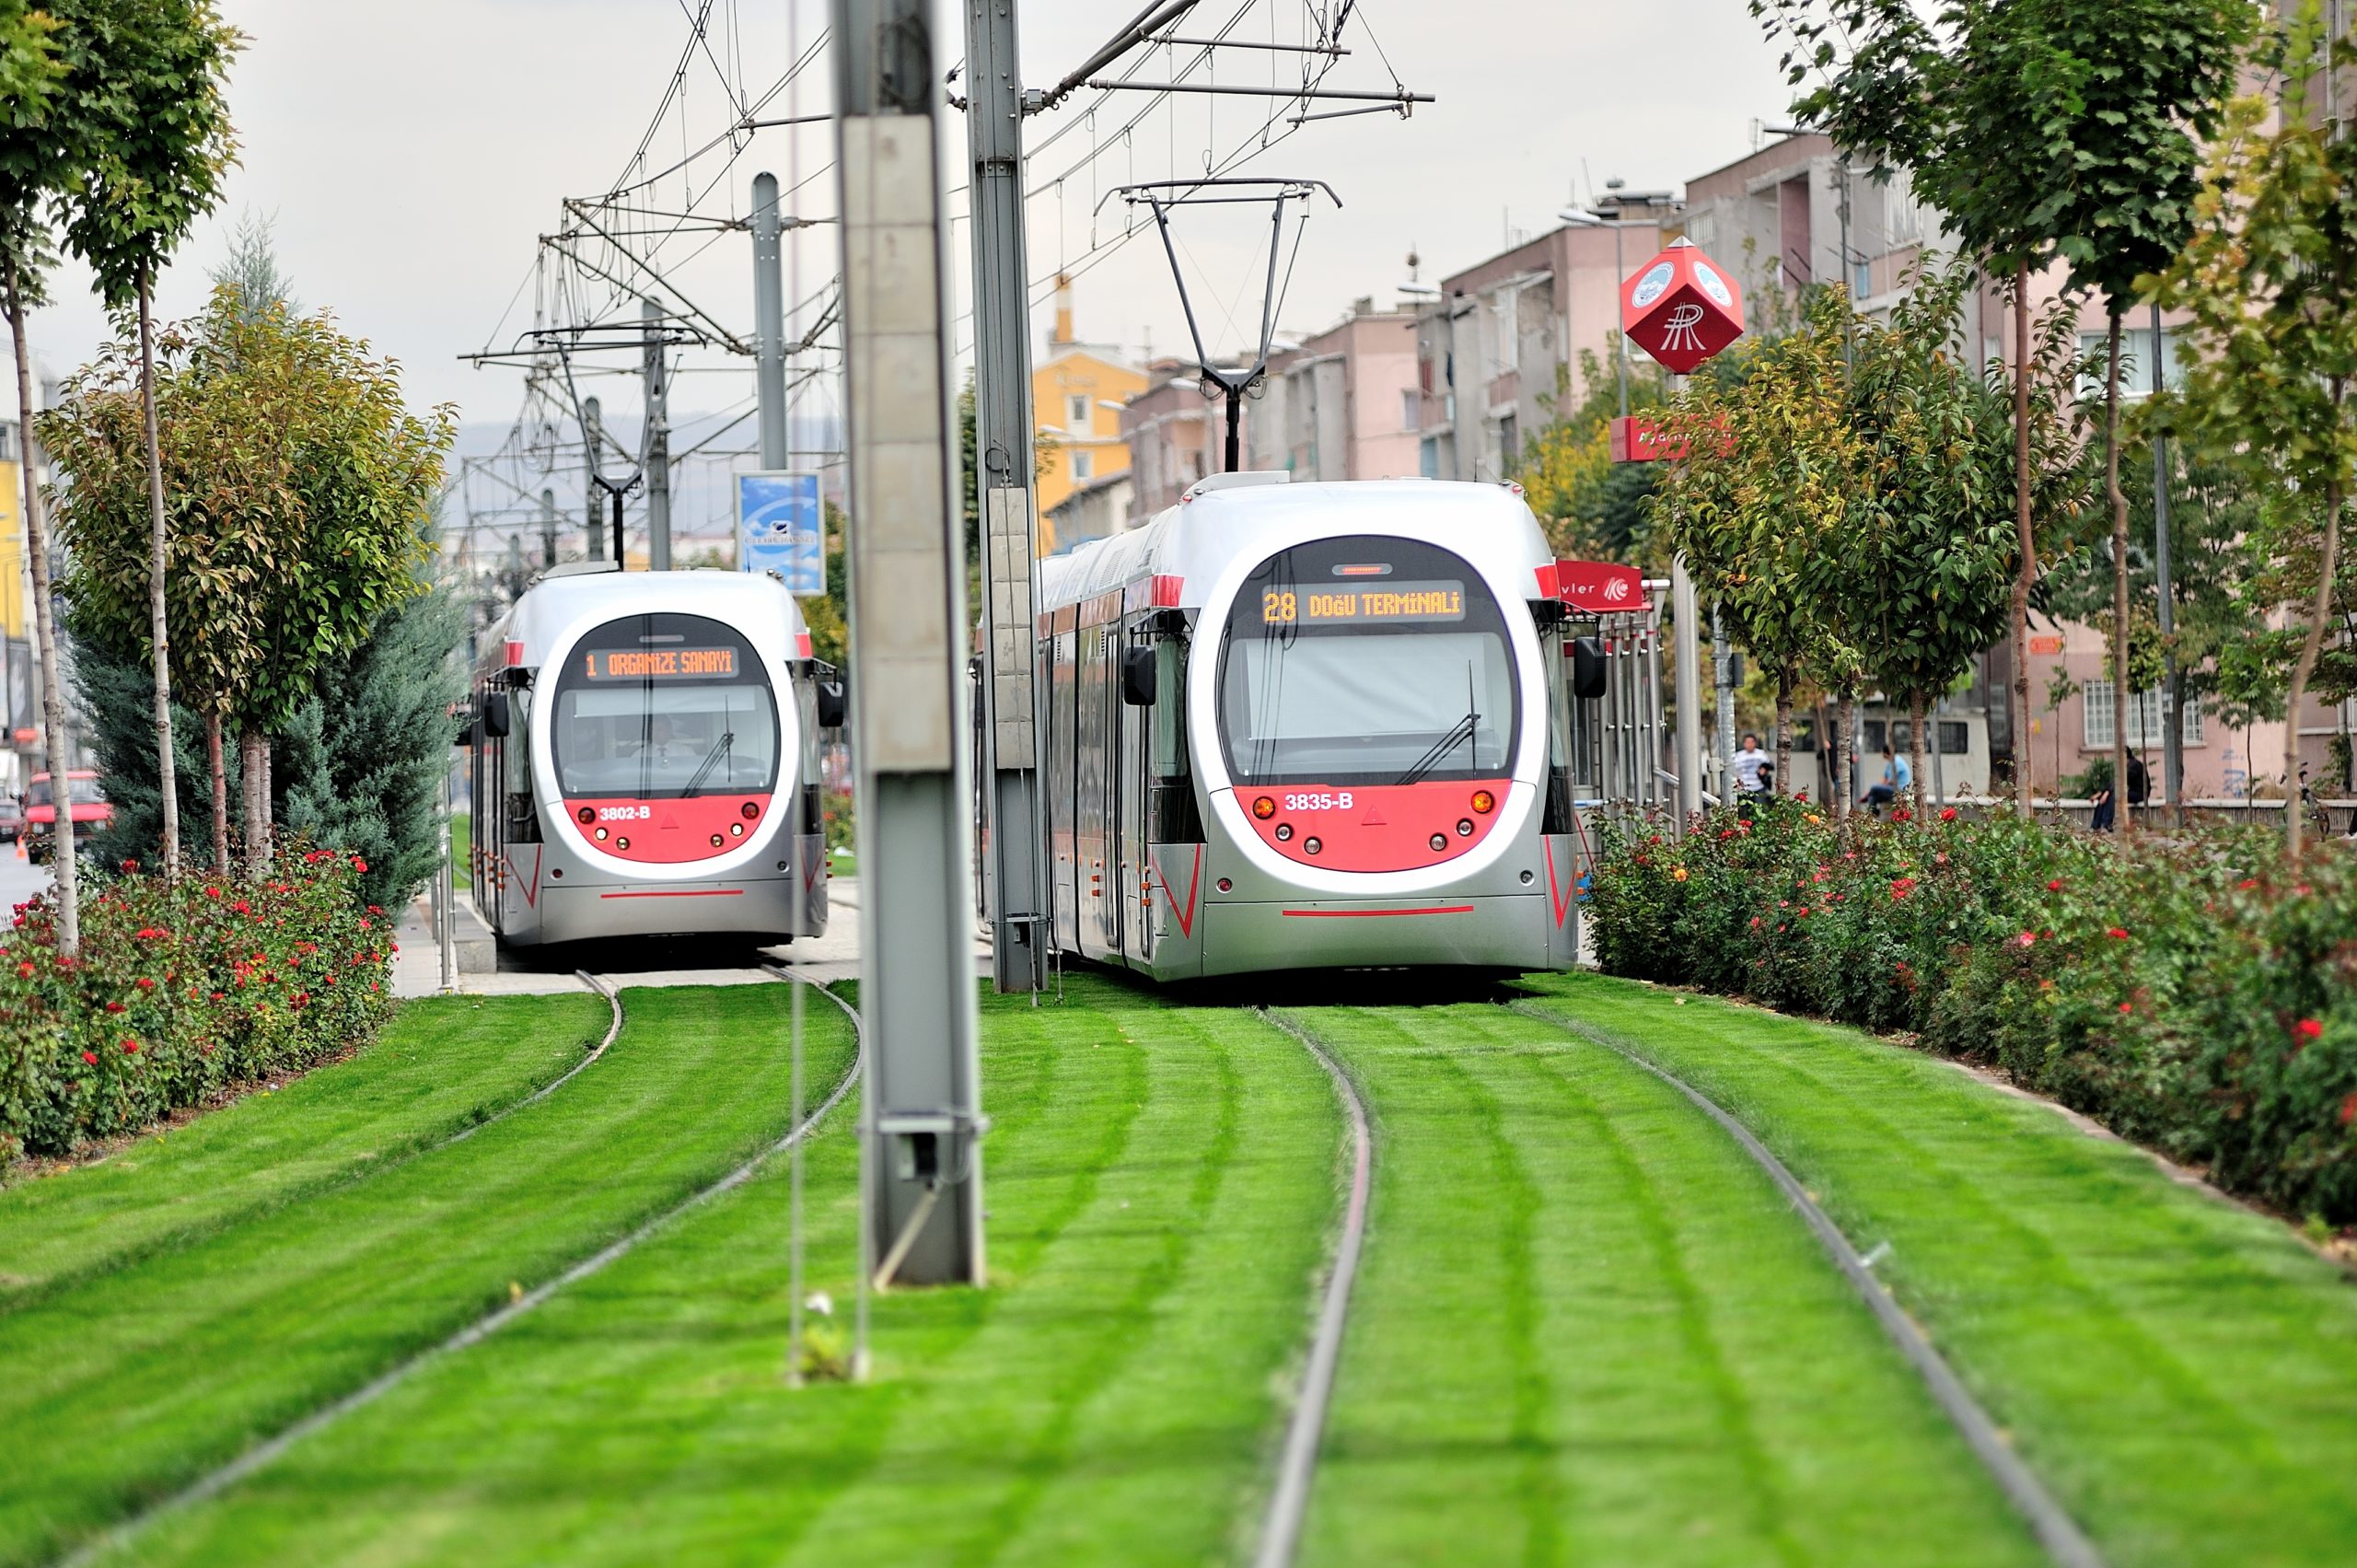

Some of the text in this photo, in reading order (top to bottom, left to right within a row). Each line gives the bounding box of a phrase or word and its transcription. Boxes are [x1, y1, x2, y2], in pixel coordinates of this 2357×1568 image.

[1264, 591, 1460, 621] 28 DOĞU TERMİNALİ
[586, 650, 732, 677] 1 ORGANİZE SANAYİ
[599, 805, 651, 821] 3802-B
[1284, 792, 1353, 811] 3835-B
